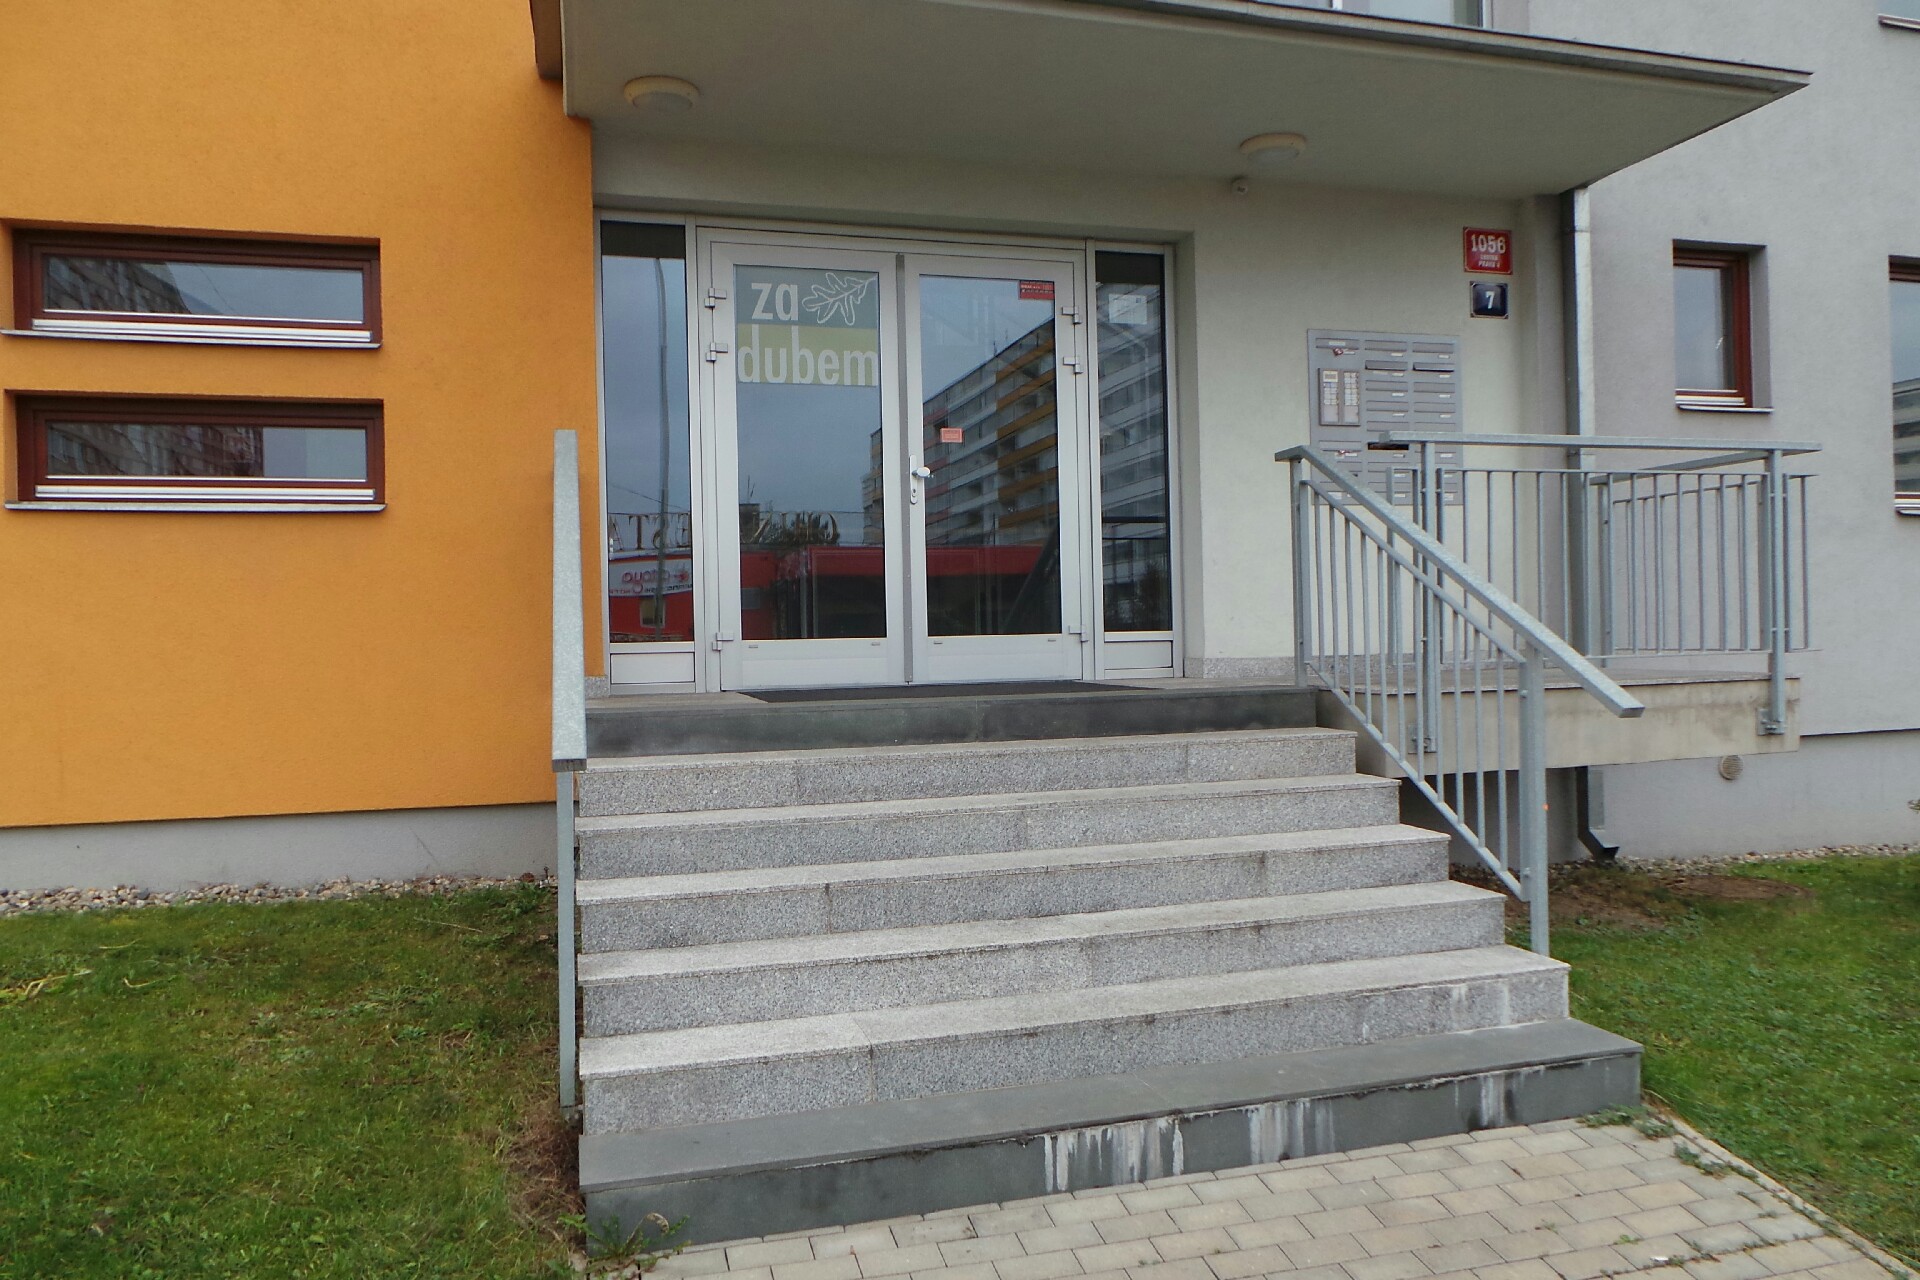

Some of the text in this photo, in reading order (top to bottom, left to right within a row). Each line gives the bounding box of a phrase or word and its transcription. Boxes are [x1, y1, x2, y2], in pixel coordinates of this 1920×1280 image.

[1471, 234, 1506, 254] 1056
[751, 282, 799, 321] za
[1485, 291, 1495, 309] 7
[737, 324, 878, 386] dubem
